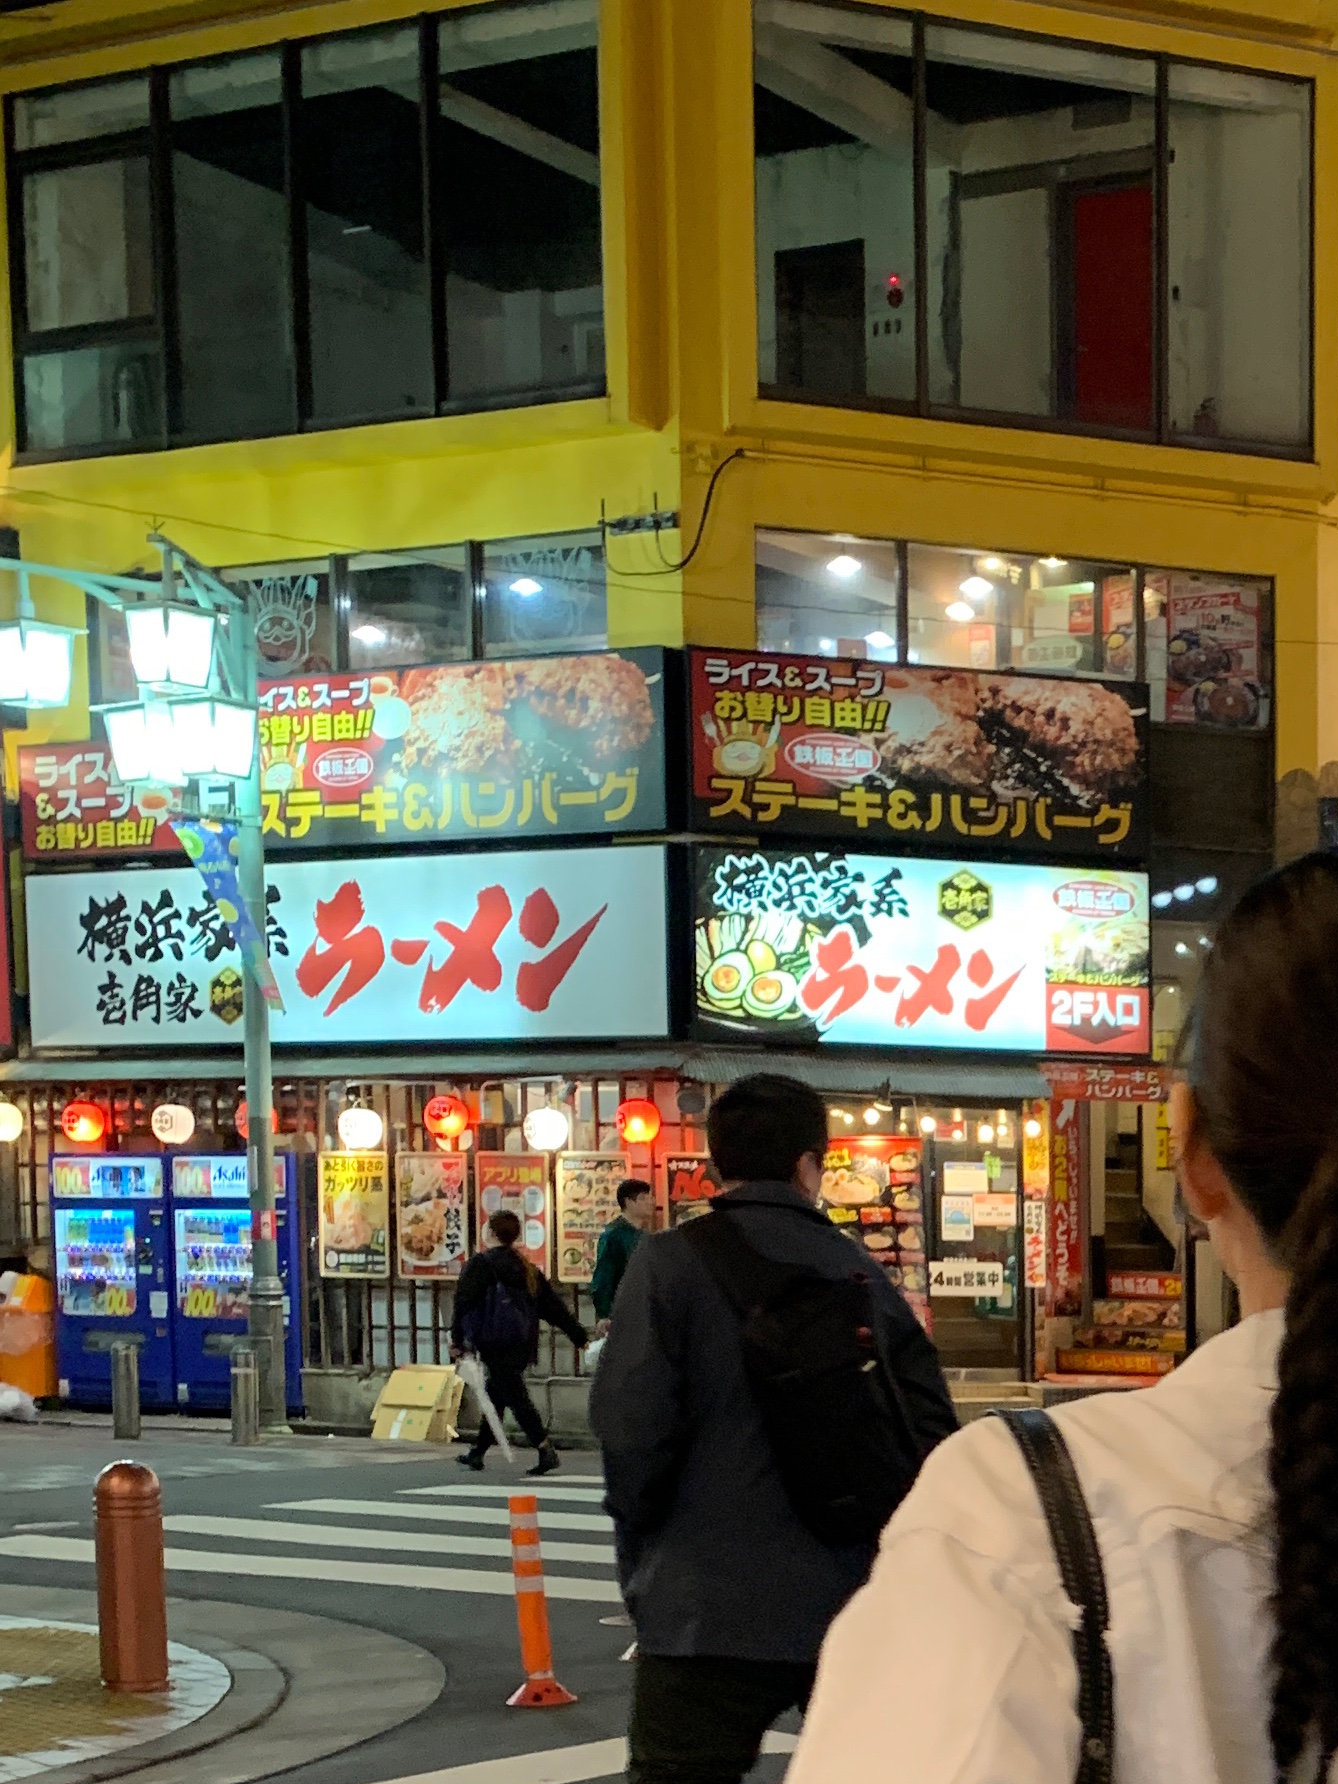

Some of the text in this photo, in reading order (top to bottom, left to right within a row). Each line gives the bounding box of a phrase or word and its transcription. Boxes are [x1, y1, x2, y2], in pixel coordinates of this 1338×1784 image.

[258, 677, 371, 712] イス&スープ
[704, 657, 884, 697] ライス&スープ
[793, 743, 873, 771] 鉄板王国
[261, 766, 641, 838] ステーキ&ハンバーグ
[708, 777, 1133, 844] ステーキ&ハンバーグ
[713, 852, 910, 920] 横浜家系
[296, 878, 609, 1018] ラーメン
[95, 969, 205, 1026] 壱角家
[800, 929, 1028, 1031] ラーメン
[1050, 990, 1141, 1028] 2F入口
[1085, 1083, 1162, 1099] ハンバーグ
[212, 1162, 247, 1182] Asahi
[928, 1269, 999, 1289] 4時間営業中
